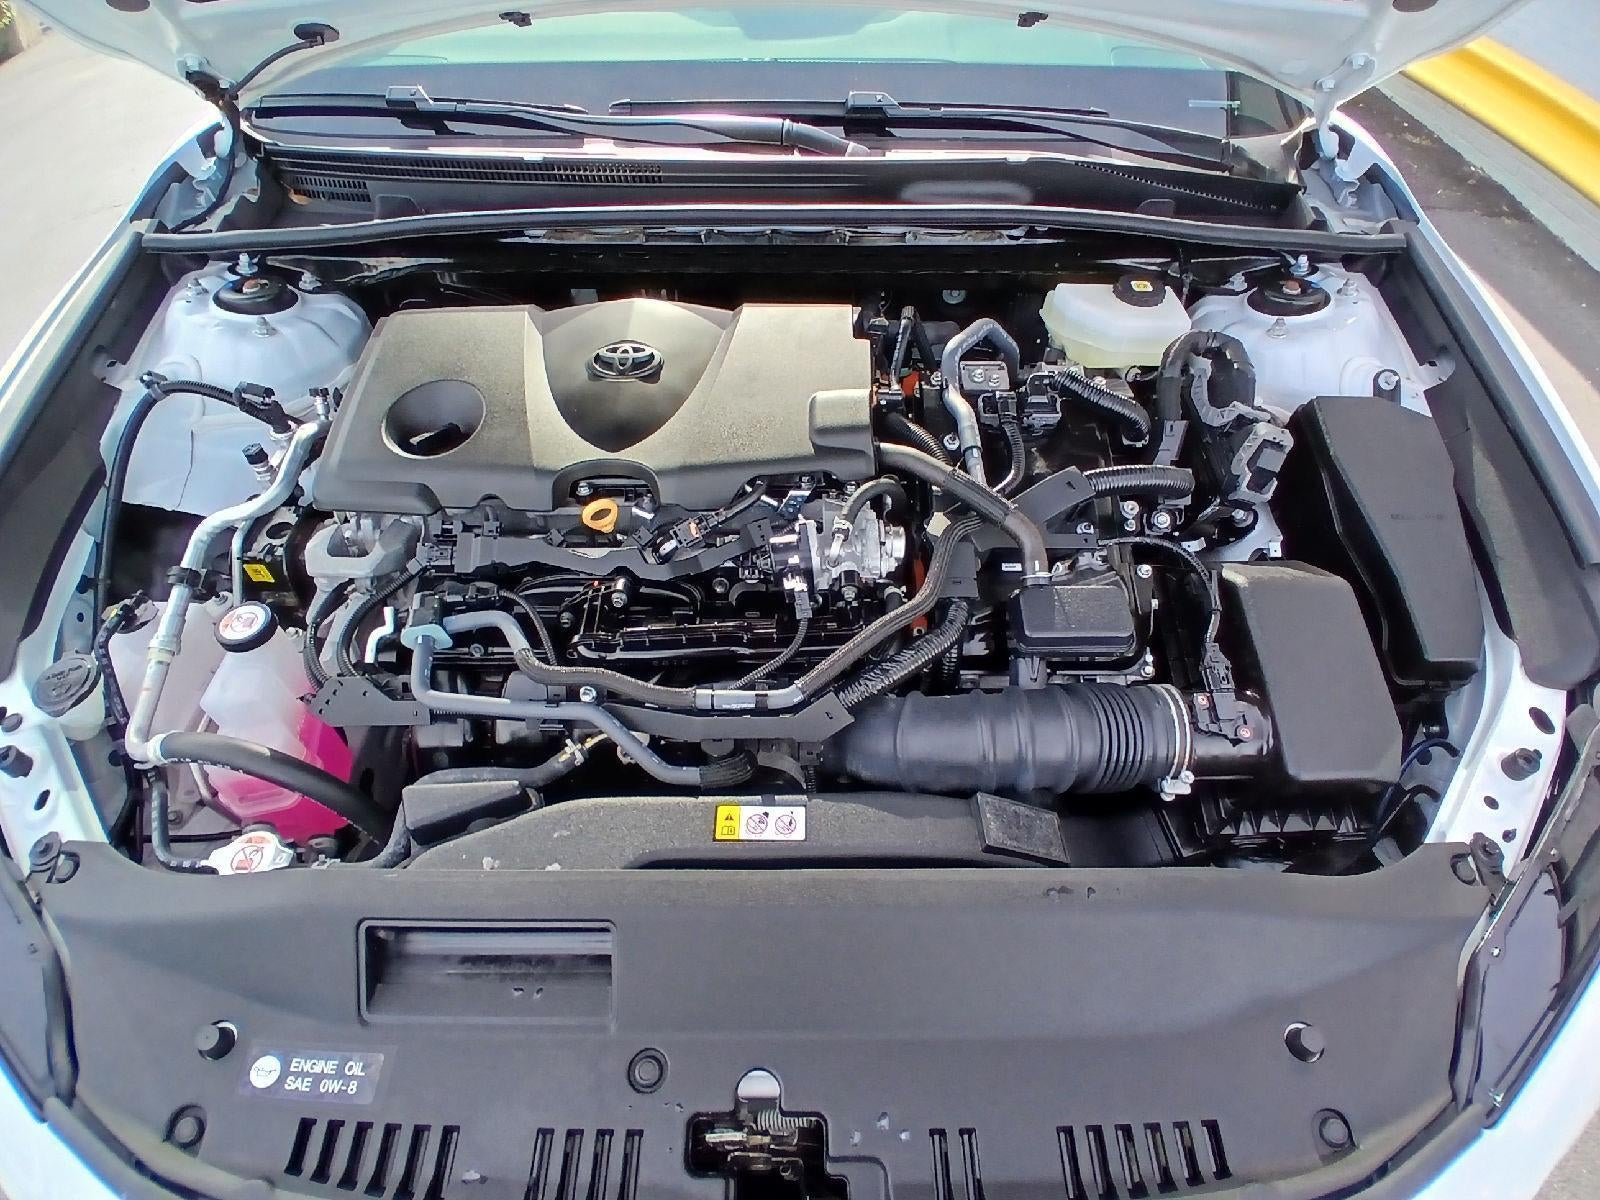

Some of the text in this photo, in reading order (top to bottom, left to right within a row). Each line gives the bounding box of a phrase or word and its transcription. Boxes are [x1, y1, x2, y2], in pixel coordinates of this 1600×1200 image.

[289, 1057, 366, 1076] ENGINE OIL
[284, 1075, 358, 1095] SAE 0W-8
